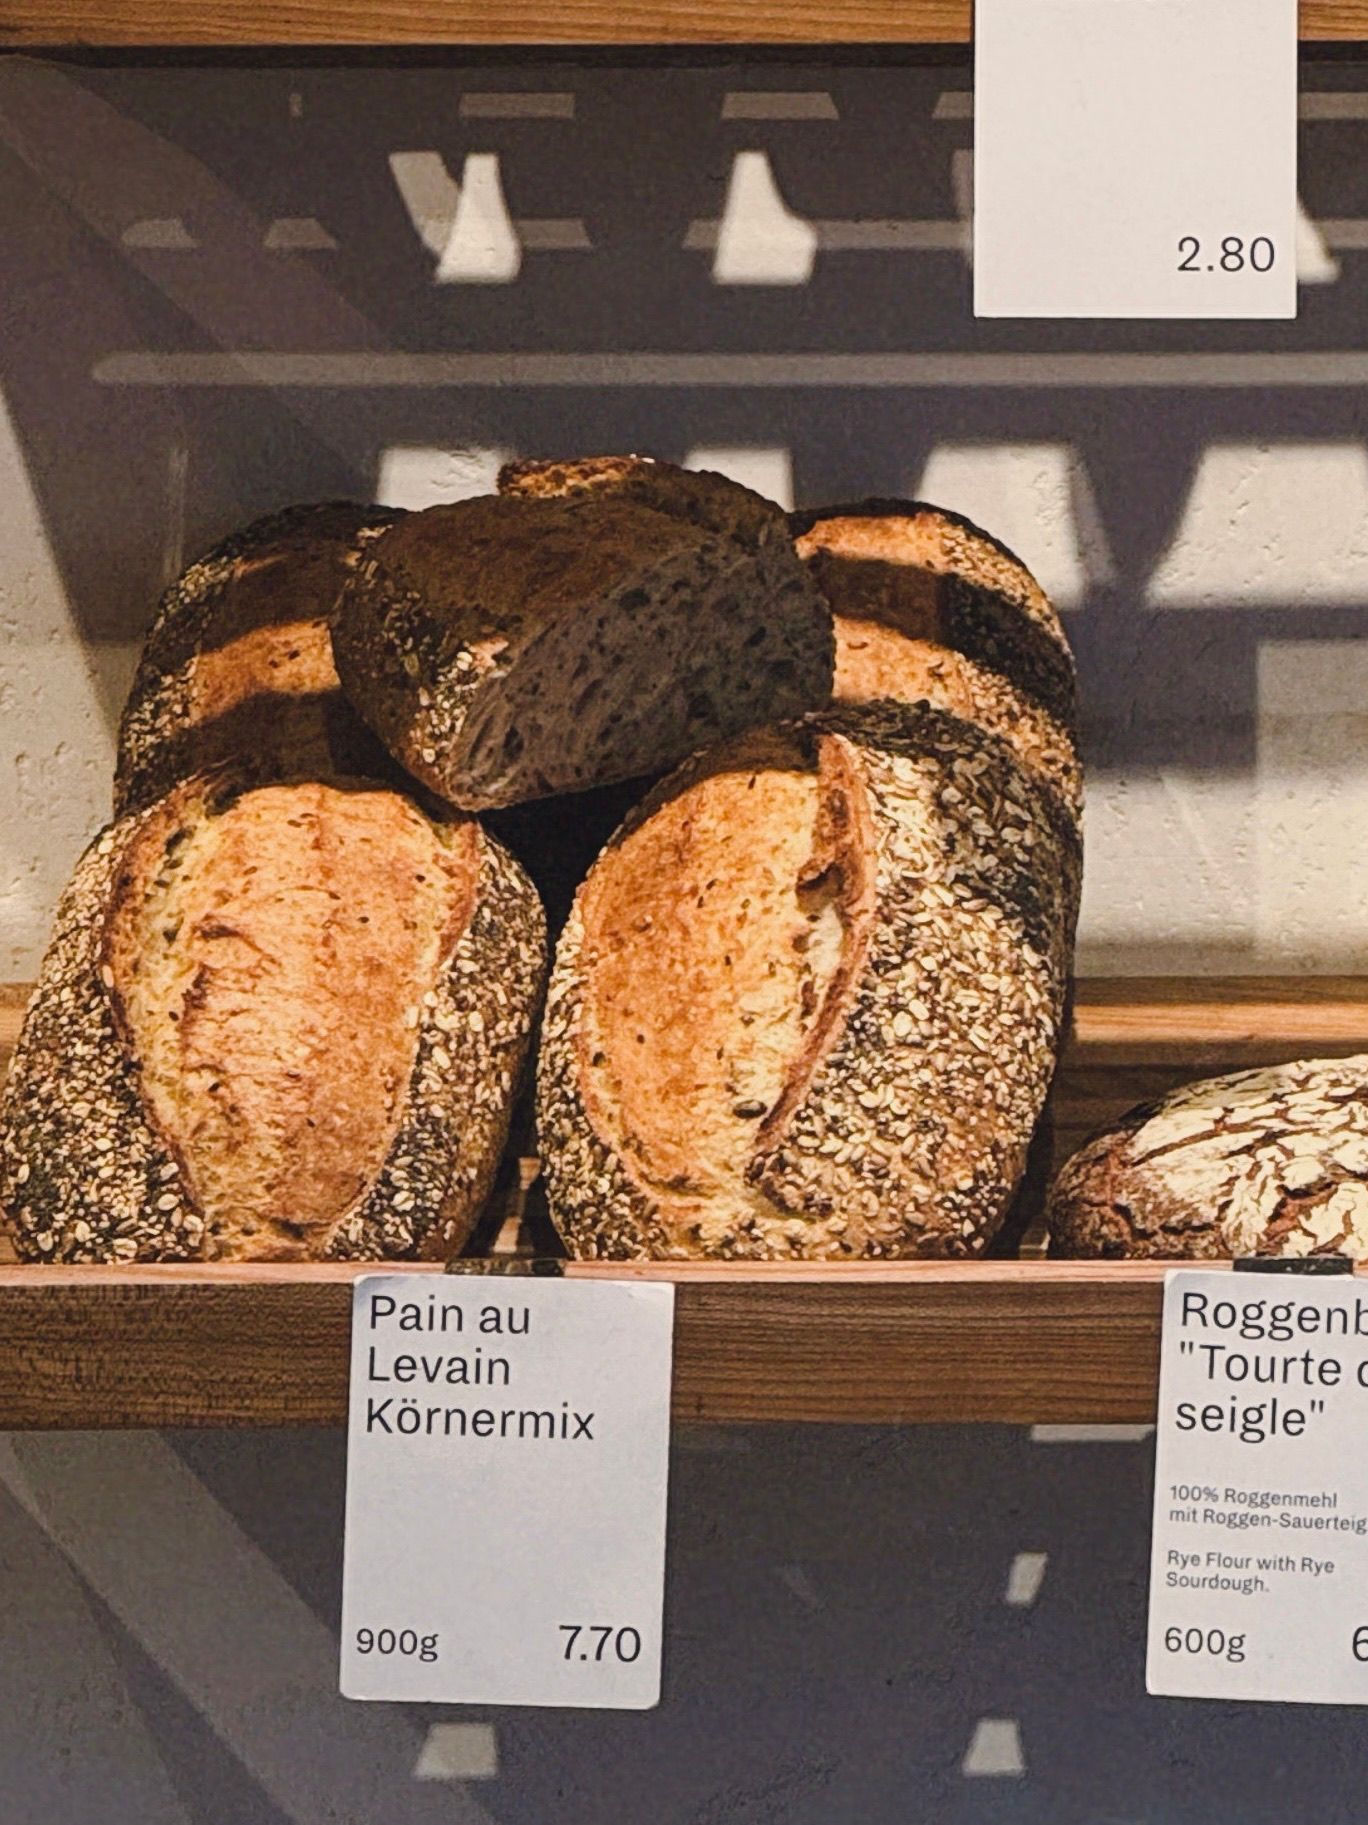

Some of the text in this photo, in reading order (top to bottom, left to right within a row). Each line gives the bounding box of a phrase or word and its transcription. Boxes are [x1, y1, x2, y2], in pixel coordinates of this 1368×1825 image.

[1177, 236, 1275, 272] 2.80
[370, 1294, 530, 1334] Pain au
[368, 1346, 510, 1386] Levain
[1180, 1341, 1342, 1386] "Tourte
[367, 1397, 595, 1440] Körnermix
[1175, 1395, 1324, 1444] seigle"
[1169, 1507, 1197, 1523] mit
[1170, 1485, 1337, 1509] 100% Roggenmehl
[1167, 1550, 1335, 1576] Rye Flour with Rye
[1166, 1571, 1269, 1595] Sourdough.
[356, 1628, 439, 1663] 900g
[559, 1625, 641, 1663] 7.70
[1164, 1626, 1246, 1663] 600g
